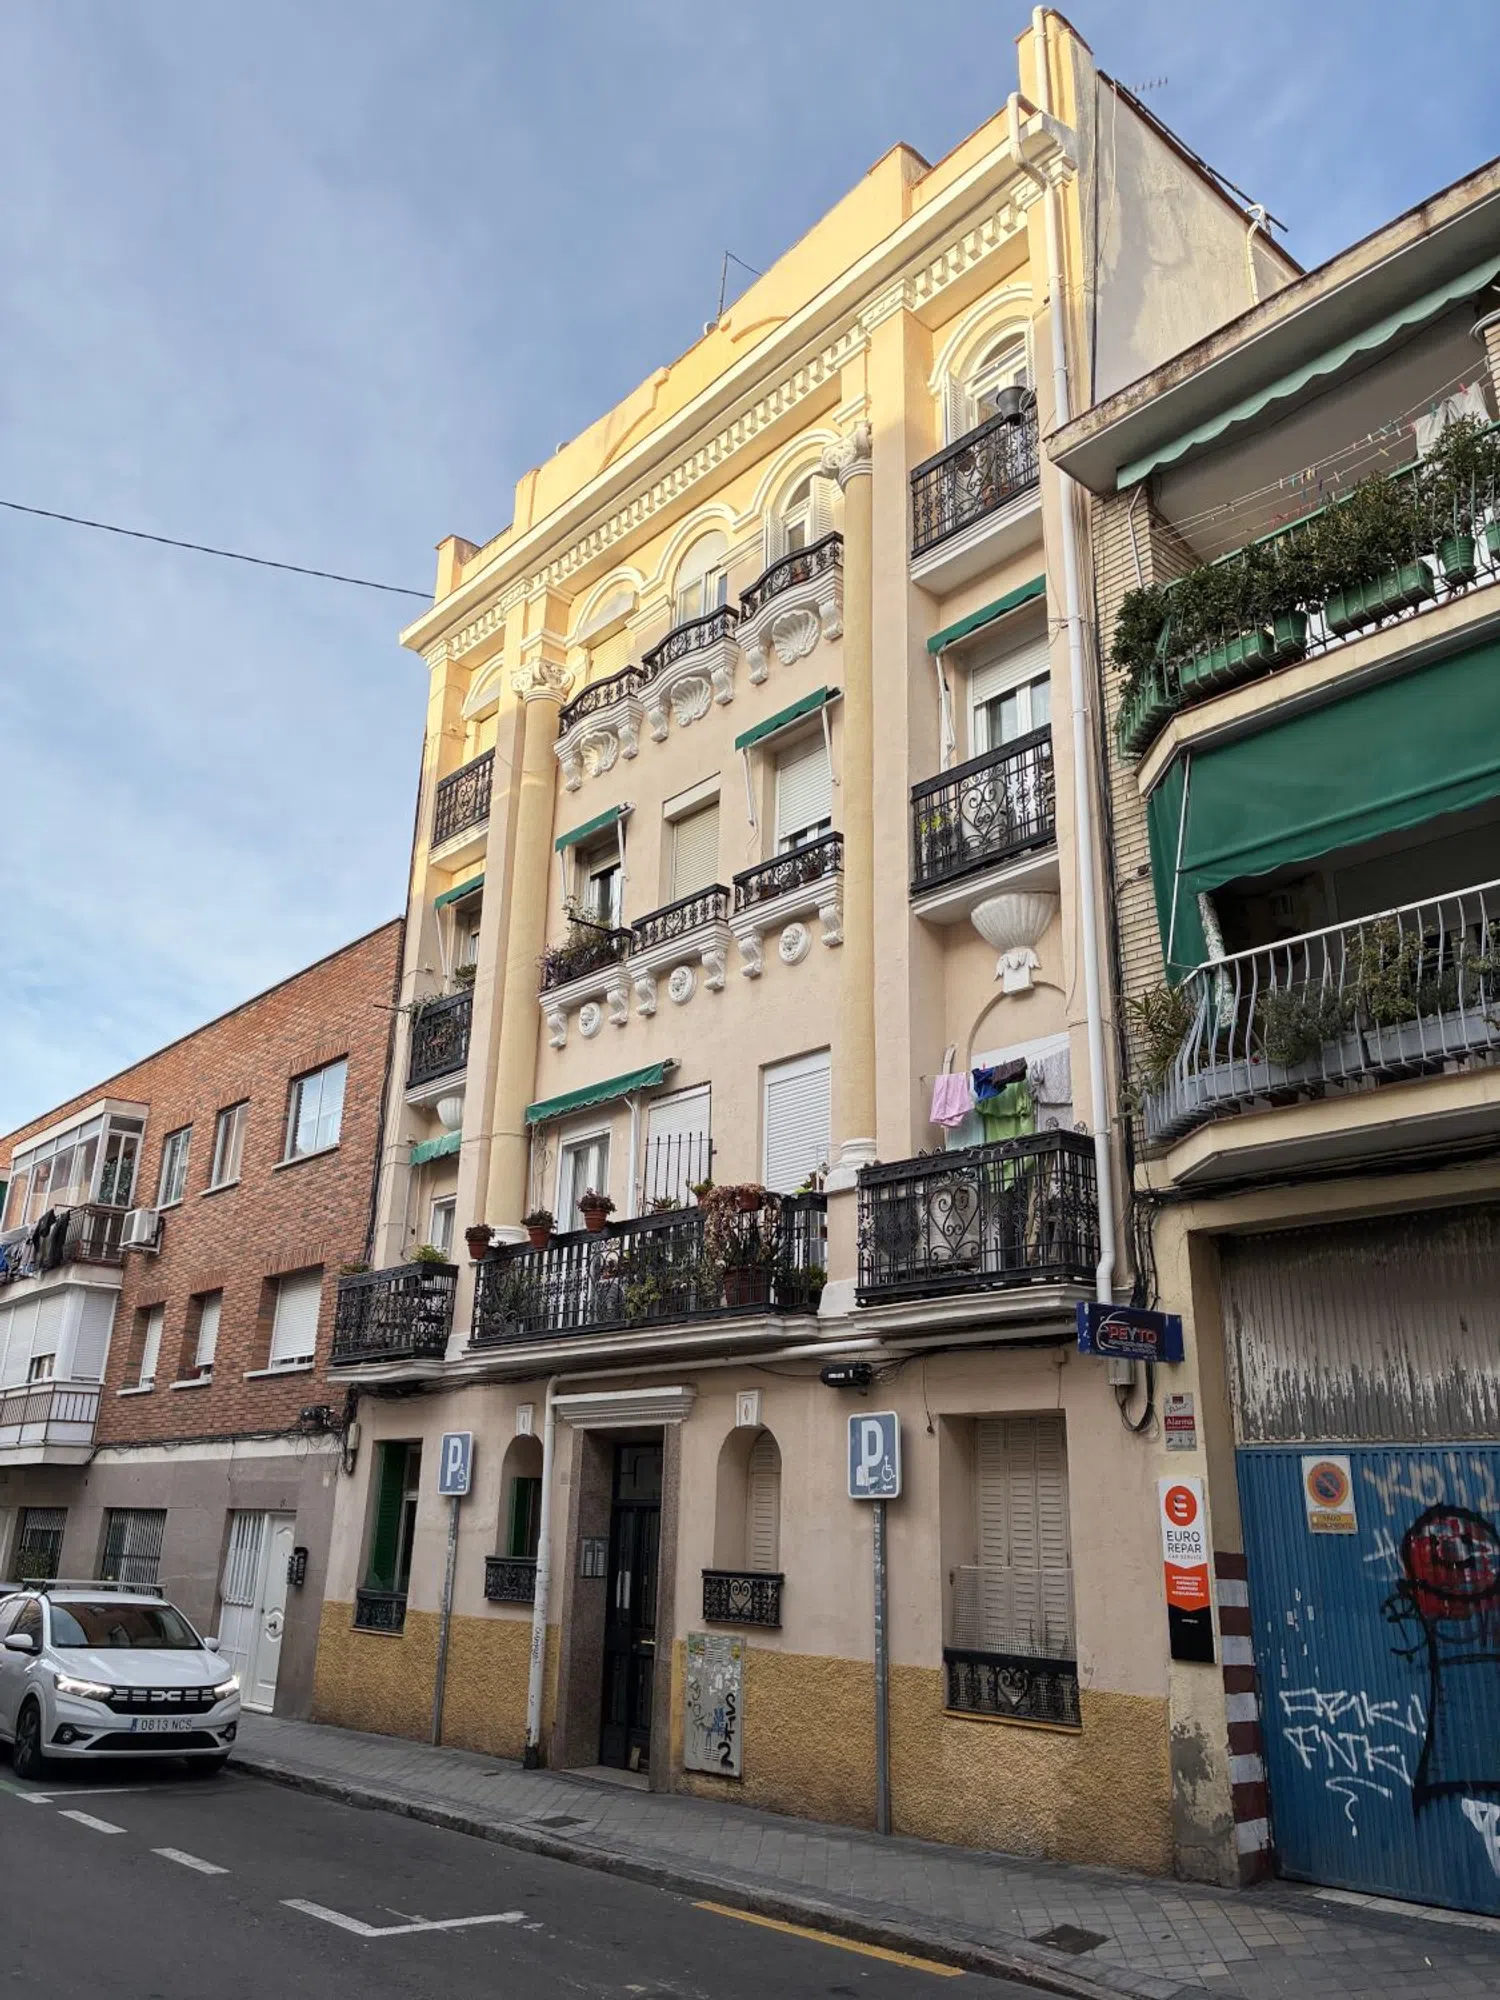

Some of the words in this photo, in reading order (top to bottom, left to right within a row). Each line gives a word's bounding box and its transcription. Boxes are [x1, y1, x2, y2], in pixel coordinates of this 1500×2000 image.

[1109, 1325, 1157, 1344] PEYTO
[862, 1420, 884, 1486] P
[446, 1438, 462, 1486] P
[1166, 1530, 1201, 1543] EURO
[1167, 1542, 1202, 1553] REPAR
[141, 1719, 169, 1731] 0813
